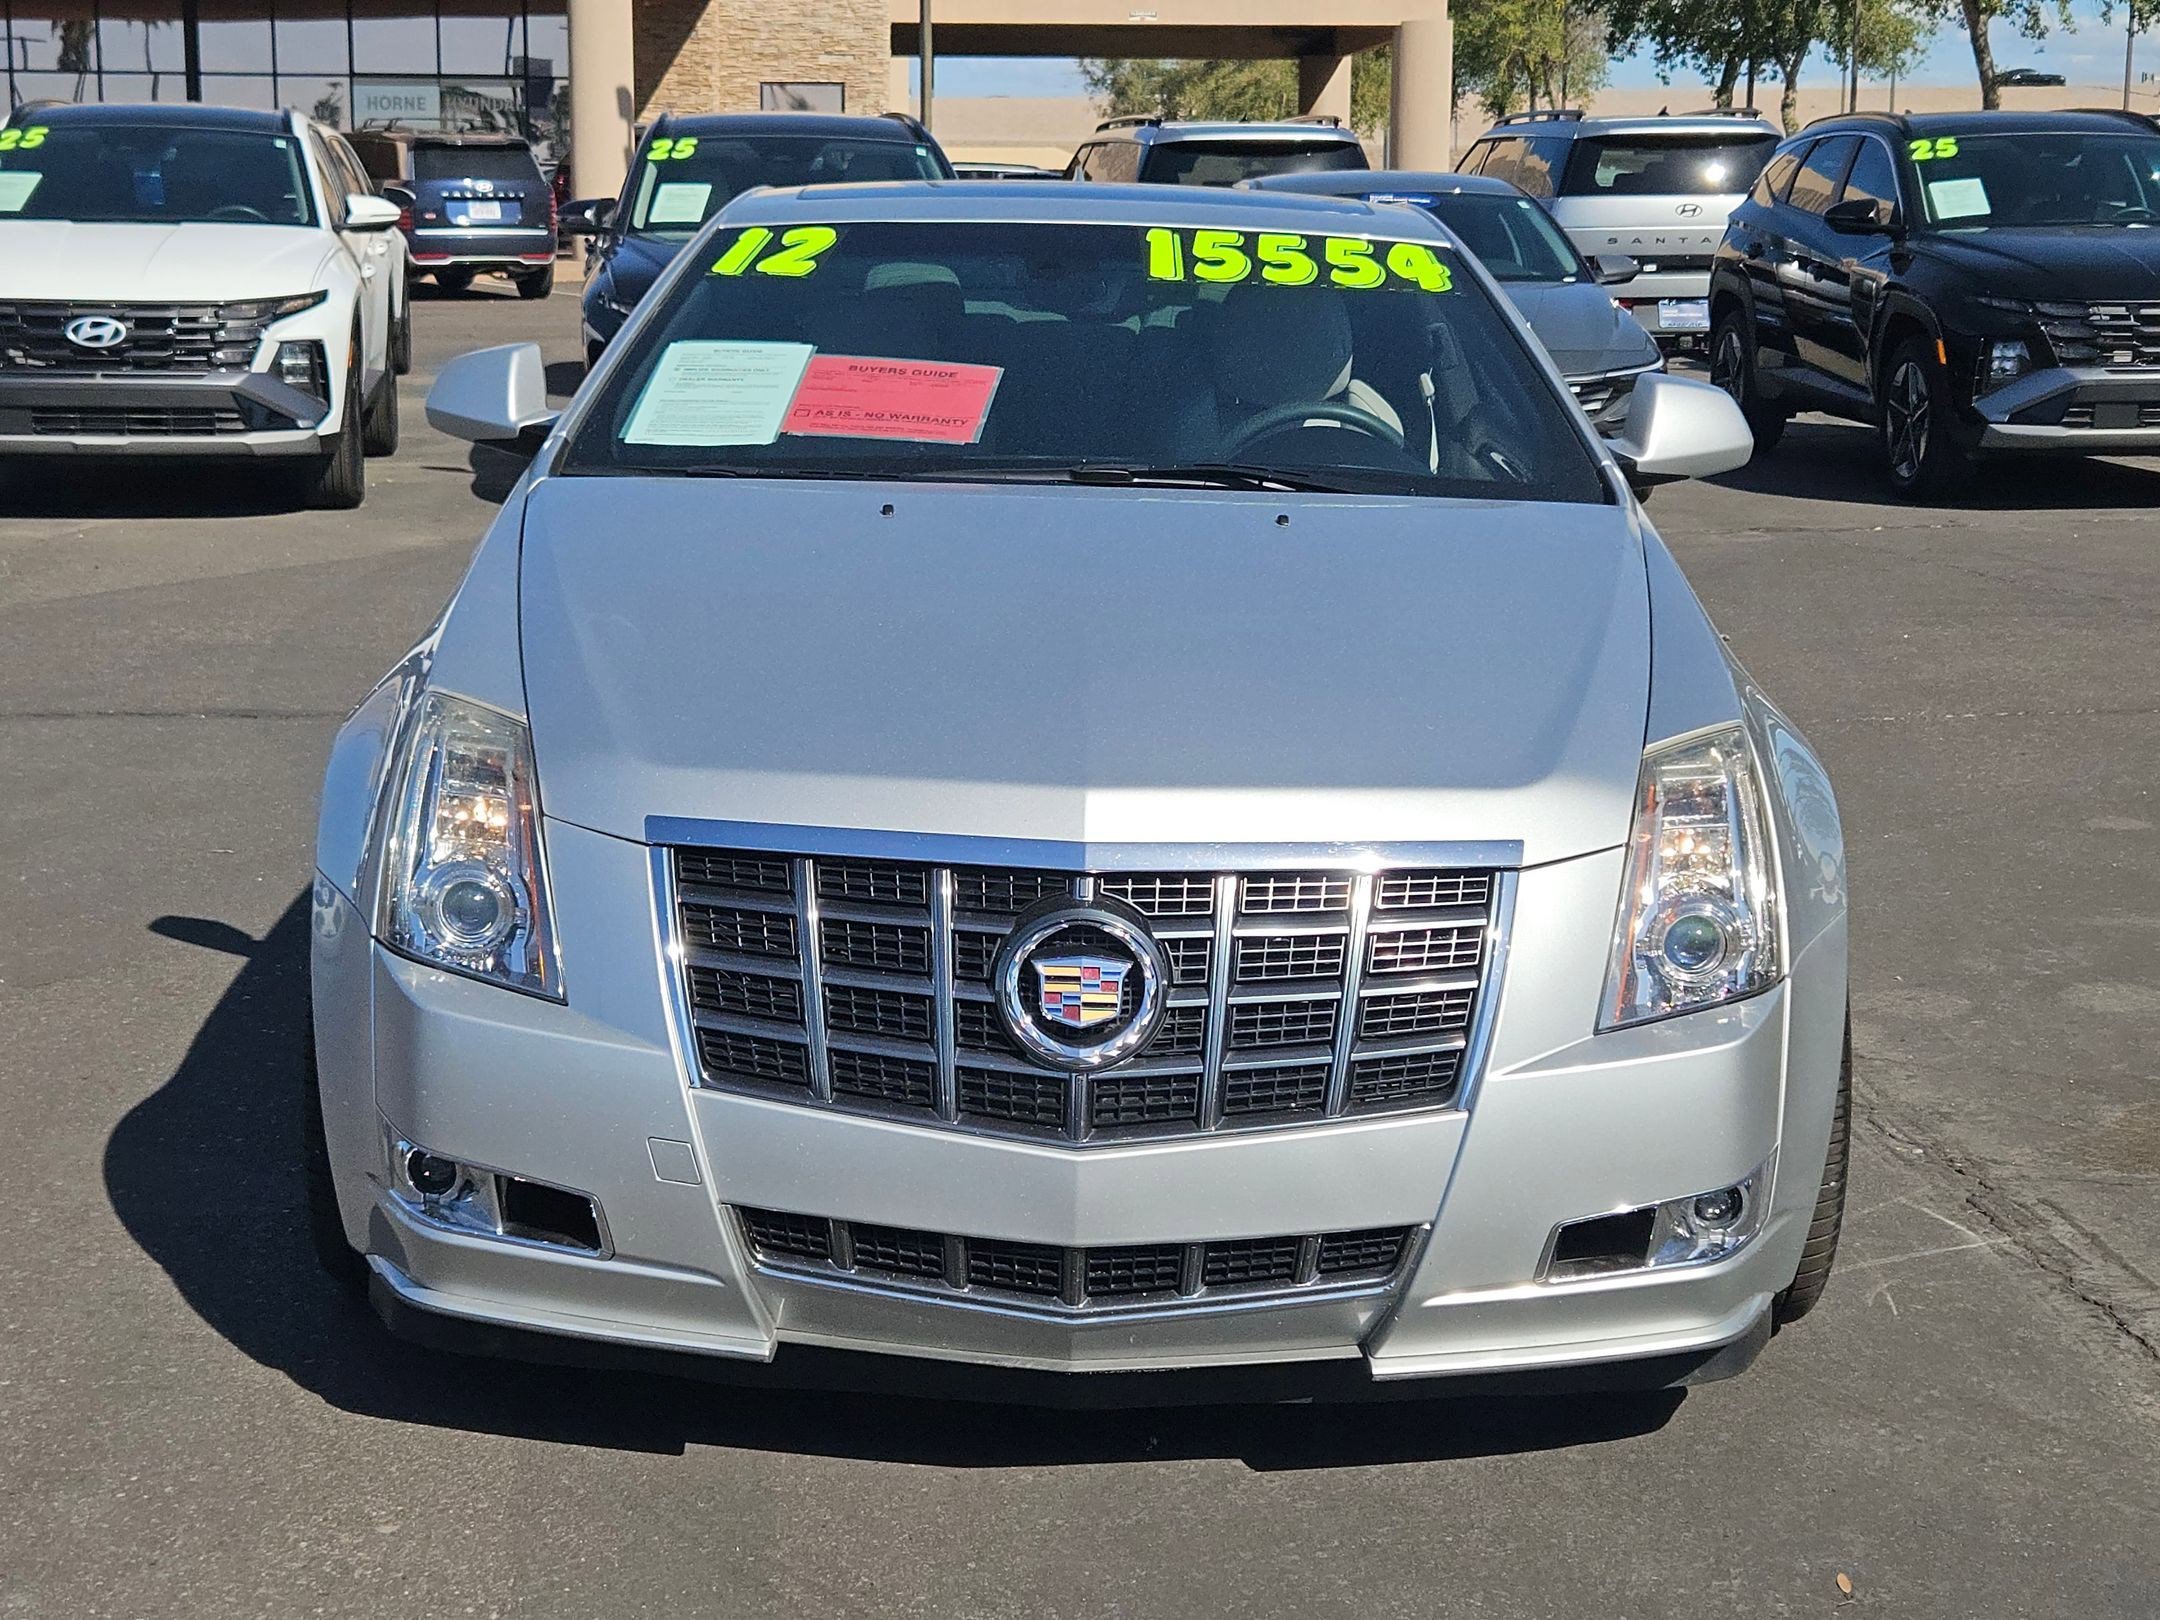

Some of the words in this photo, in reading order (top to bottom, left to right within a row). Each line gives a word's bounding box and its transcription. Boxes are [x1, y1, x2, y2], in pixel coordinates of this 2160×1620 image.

[367, 96, 427, 111] HORNE
[0, 126, 50, 151] 25
[646, 136, 699, 161] 25
[1908, 136, 1959, 161] 25
[711, 226, 838, 278] 12
[1607, 237, 1712, 245] SANTA
[1145, 227, 1453, 293] 15554
[849, 364, 907, 375] BUYERS
[911, 368, 959, 378] GUIDE
[837, 410, 852, 418] IS
[863, 411, 886, 419] NO
[888, 412, 969, 426] WARRANTY
